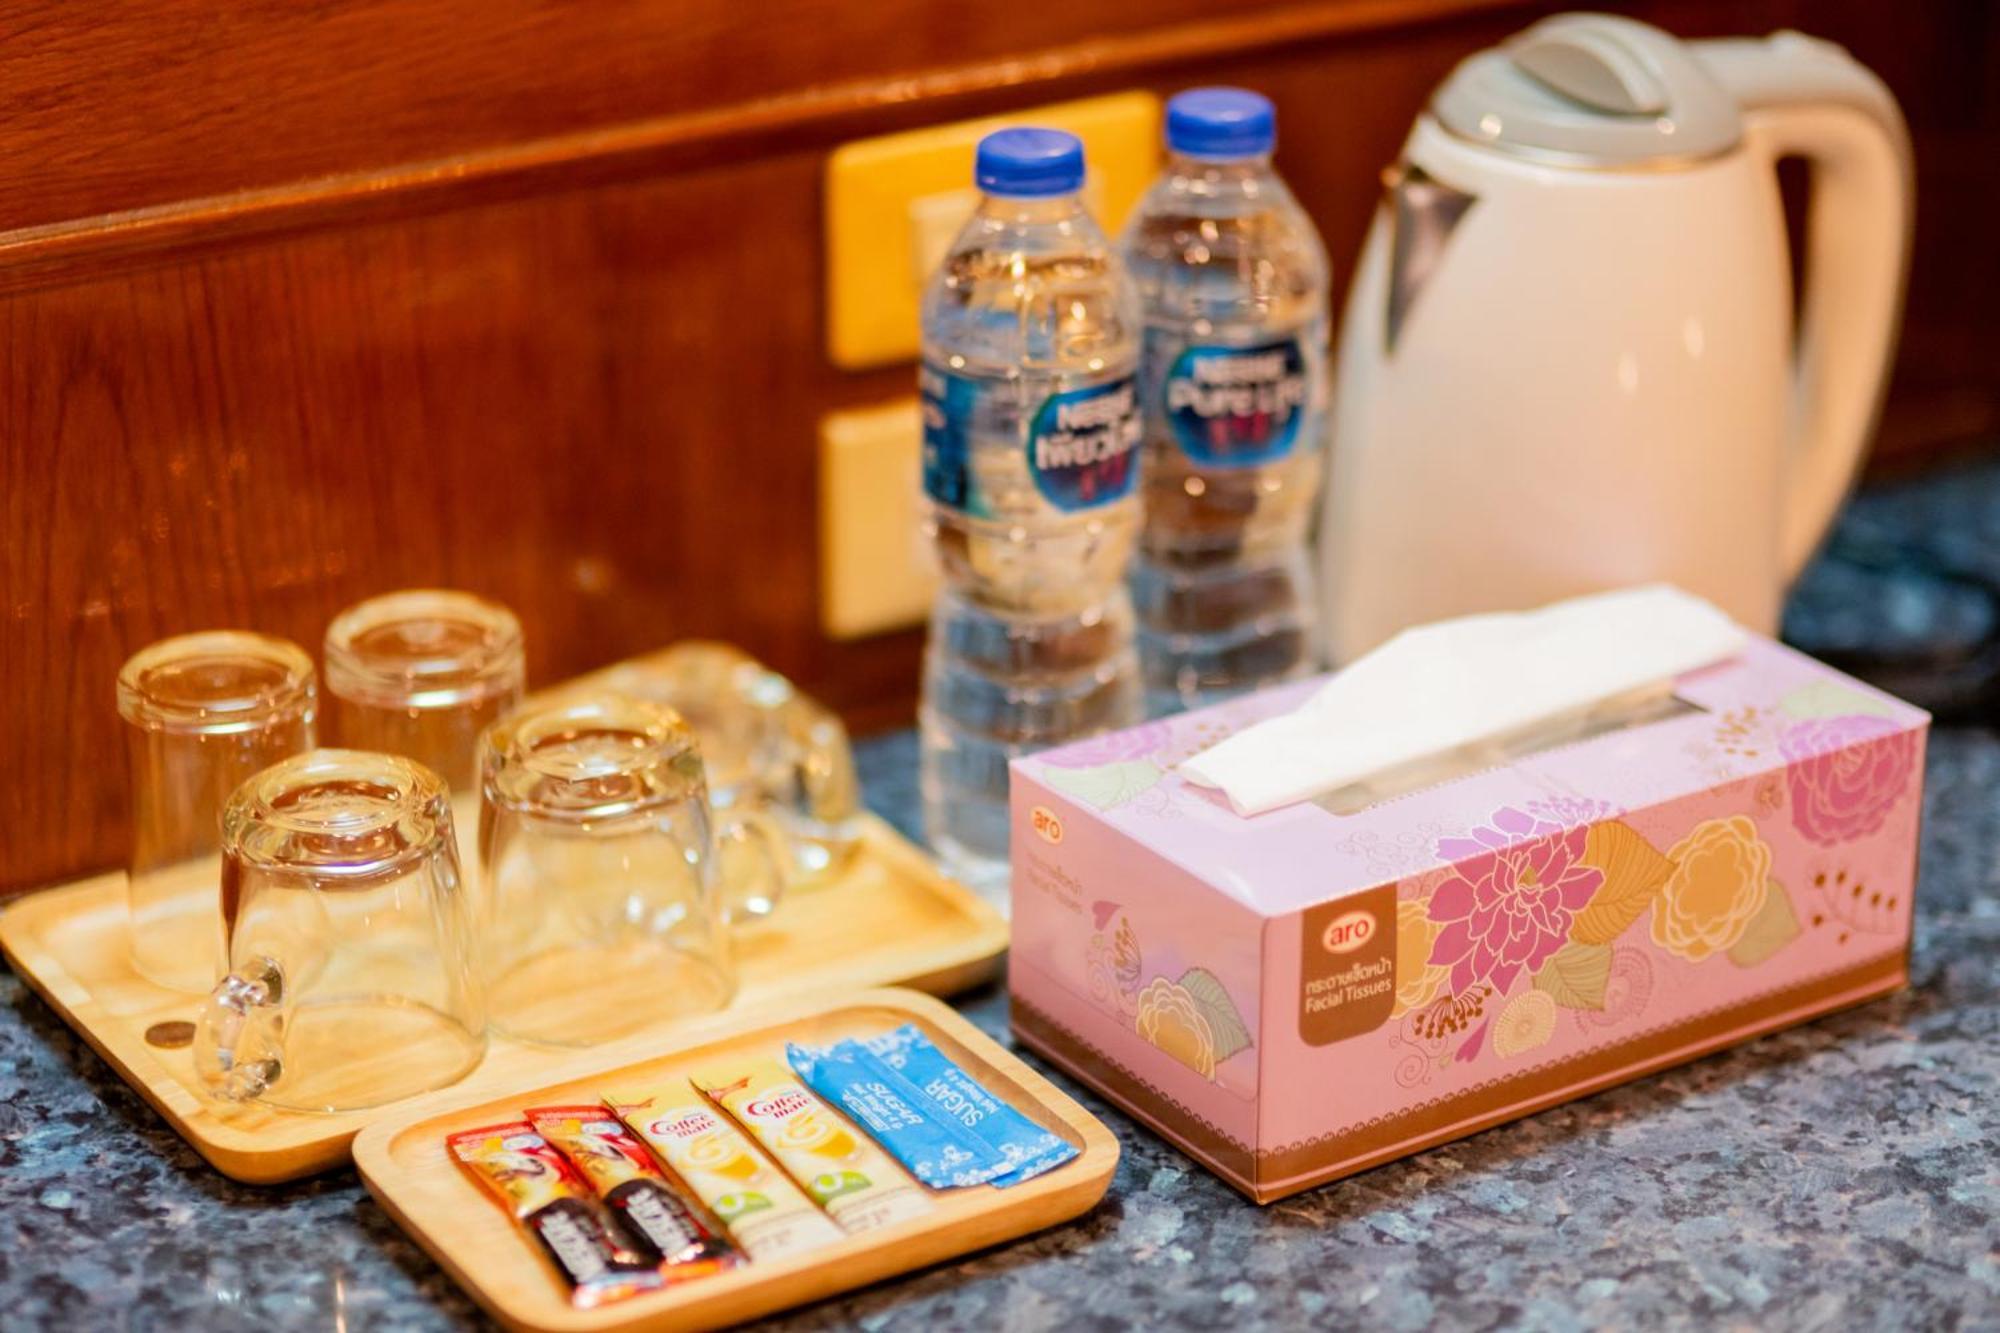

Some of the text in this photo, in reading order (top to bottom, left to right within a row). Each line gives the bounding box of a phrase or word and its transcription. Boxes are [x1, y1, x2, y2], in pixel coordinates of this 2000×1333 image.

[1033, 810, 1060, 840] aro
[1329, 918, 1370, 946] aro
[1304, 978, 1392, 1014] Facial Tissues
[748, 1092, 803, 1117] Coffee
[773, 1097, 811, 1120] mate
[866, 1082, 924, 1125] SUGAR
[925, 1078, 984, 1127] SUGAR
[650, 1112, 709, 1136] Coffee
[677, 1118, 717, 1140] mate
